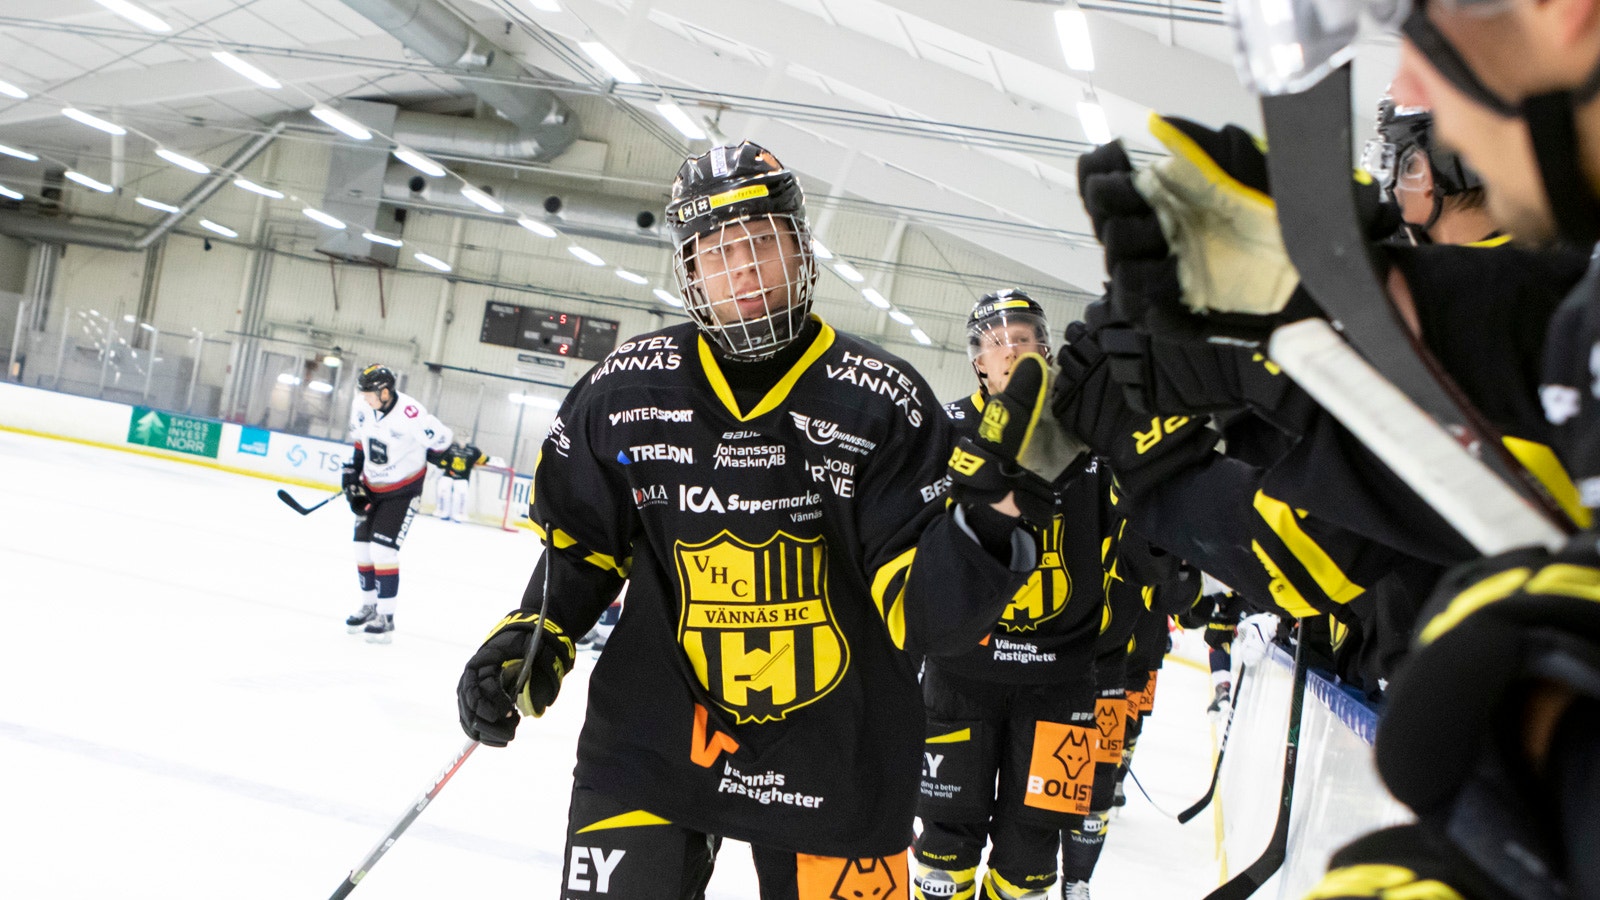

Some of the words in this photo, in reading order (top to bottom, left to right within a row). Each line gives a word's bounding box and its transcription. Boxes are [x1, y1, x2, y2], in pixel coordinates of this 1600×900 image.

[560, 314, 567, 324] 5
[560, 344, 568, 354] 2
[604, 336, 679, 362] HOTEL
[590, 352, 682, 384] VÄNNÄS
[842, 351, 922, 407] HOTEL
[826, 364, 923, 428] VÄNNÄS
[622, 406, 694, 423] INTERSPORT
[170, 417, 208, 432] SKOGS
[168, 426, 208, 441] INVEST
[166, 436, 205, 452] NORR
[713, 443, 786, 458] Johansson
[679, 484, 726, 514] ICA
[727, 489, 822, 514] Supermarke
[790, 509, 823, 523] Vännäs
[705, 608, 778, 624] VÄNNÄS
[784, 607, 809, 621] HC
[995, 639, 1038, 654] Vännäs
[718, 778, 824, 809] Fastigheter
[567, 846, 626, 894] EY
[922, 881, 955, 894] Gulf
